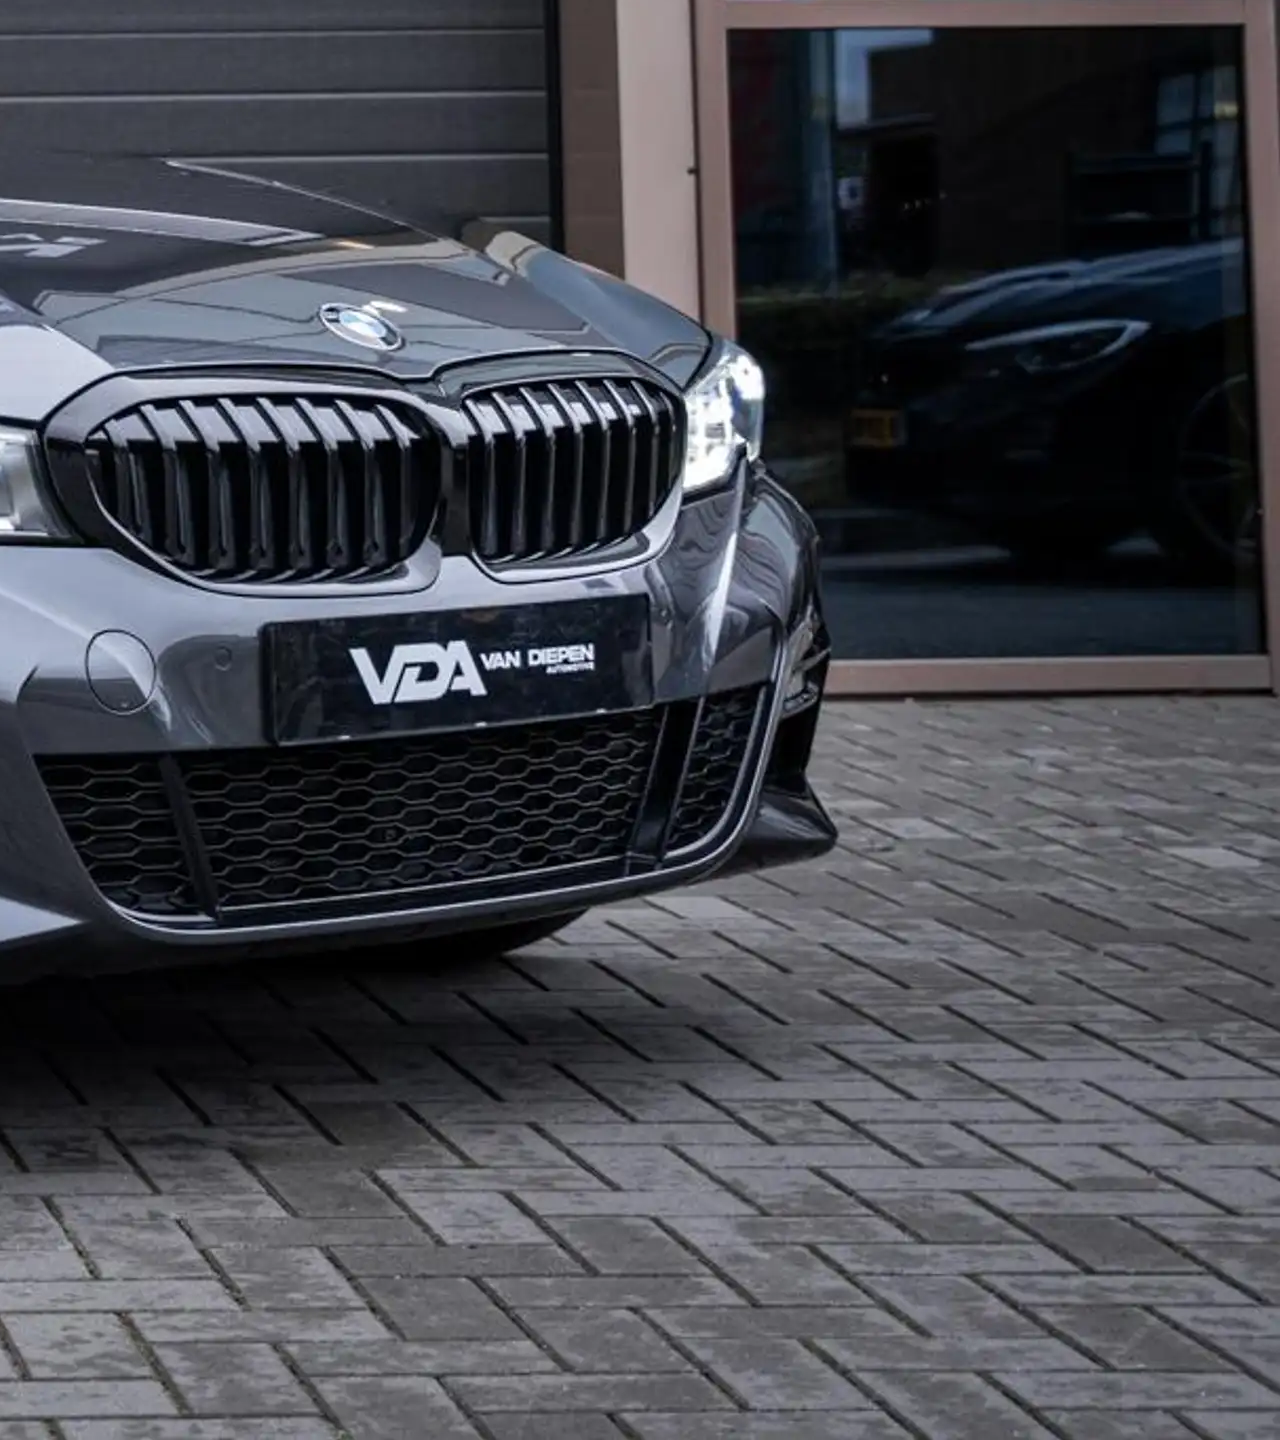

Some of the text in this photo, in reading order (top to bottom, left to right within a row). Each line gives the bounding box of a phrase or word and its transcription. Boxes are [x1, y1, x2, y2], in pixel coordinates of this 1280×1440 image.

[349, 641, 487, 704] VDA
[480, 643, 594, 670] VAN DIEPEN
